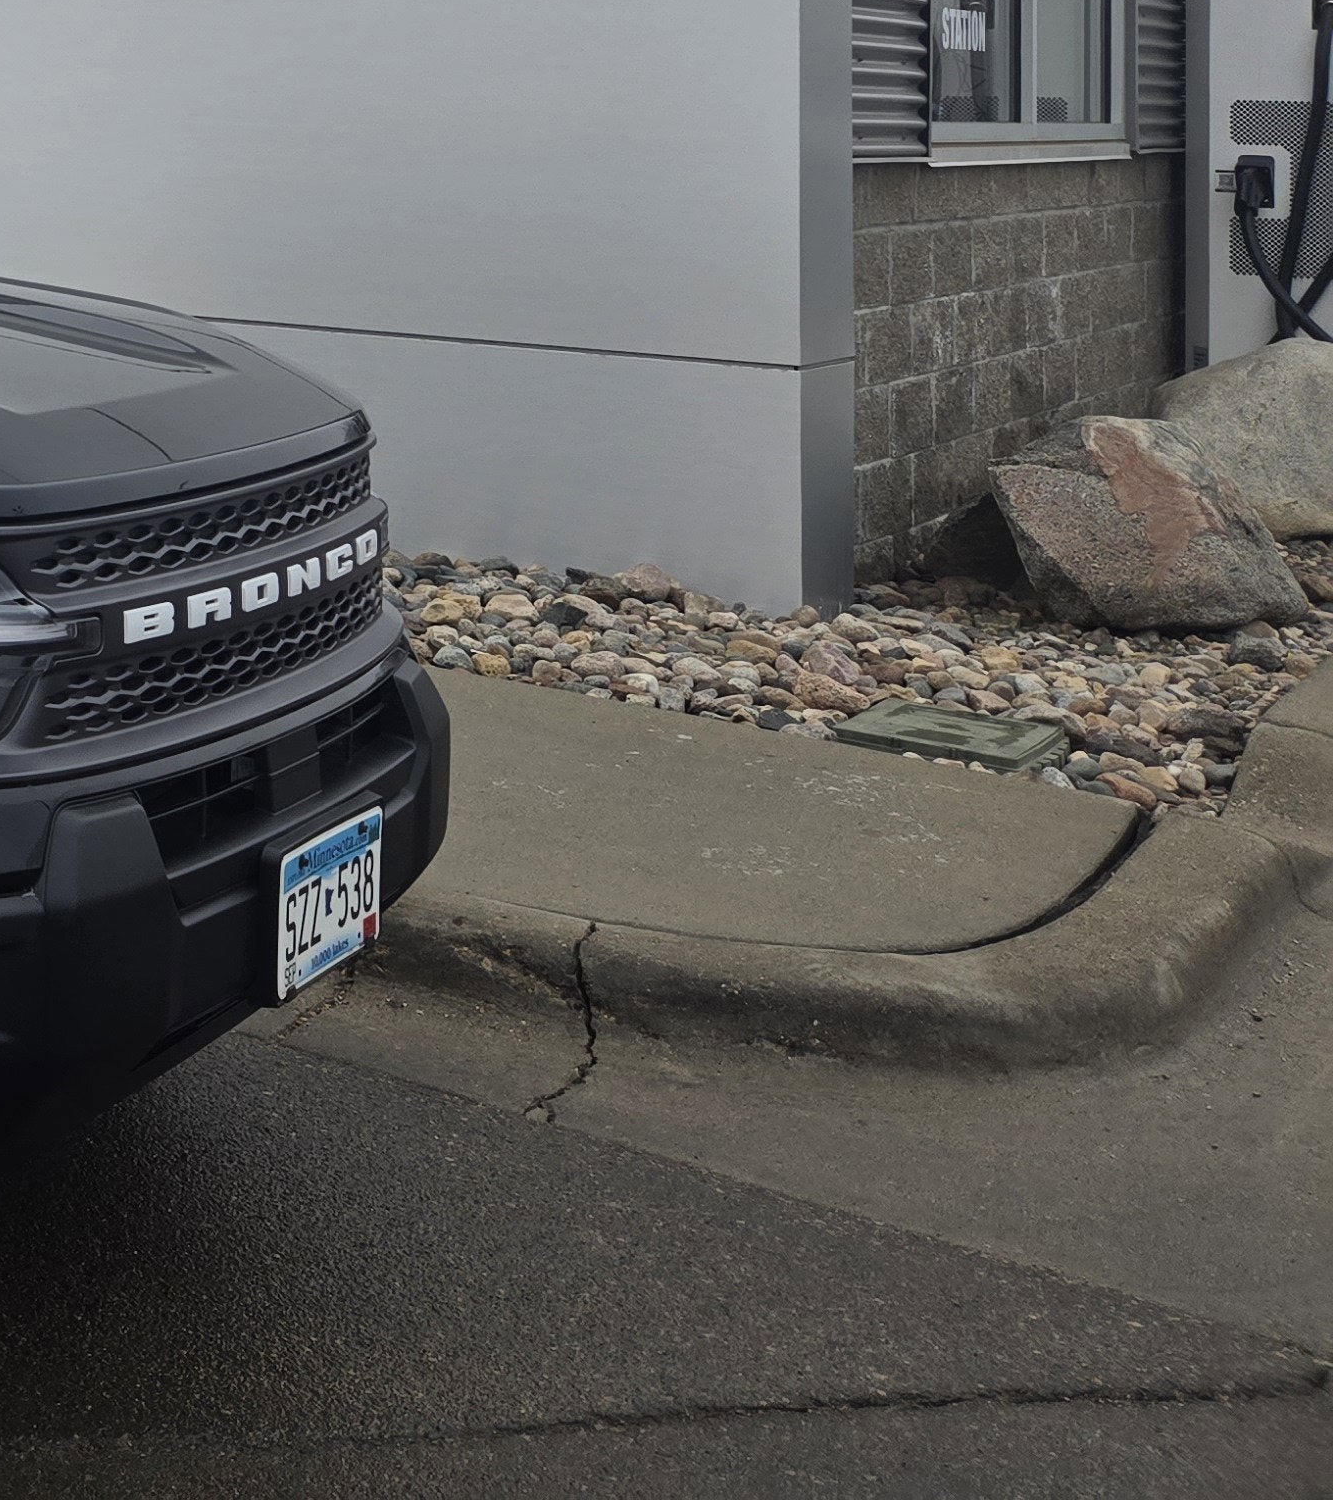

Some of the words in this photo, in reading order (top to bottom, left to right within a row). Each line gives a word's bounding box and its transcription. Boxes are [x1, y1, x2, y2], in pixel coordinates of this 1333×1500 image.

[941, 7, 986, 52] STATION
[124, 528, 379, 644] BRONCO
[286, 876, 322, 962] SZZ
[338, 849, 374, 928] 538
